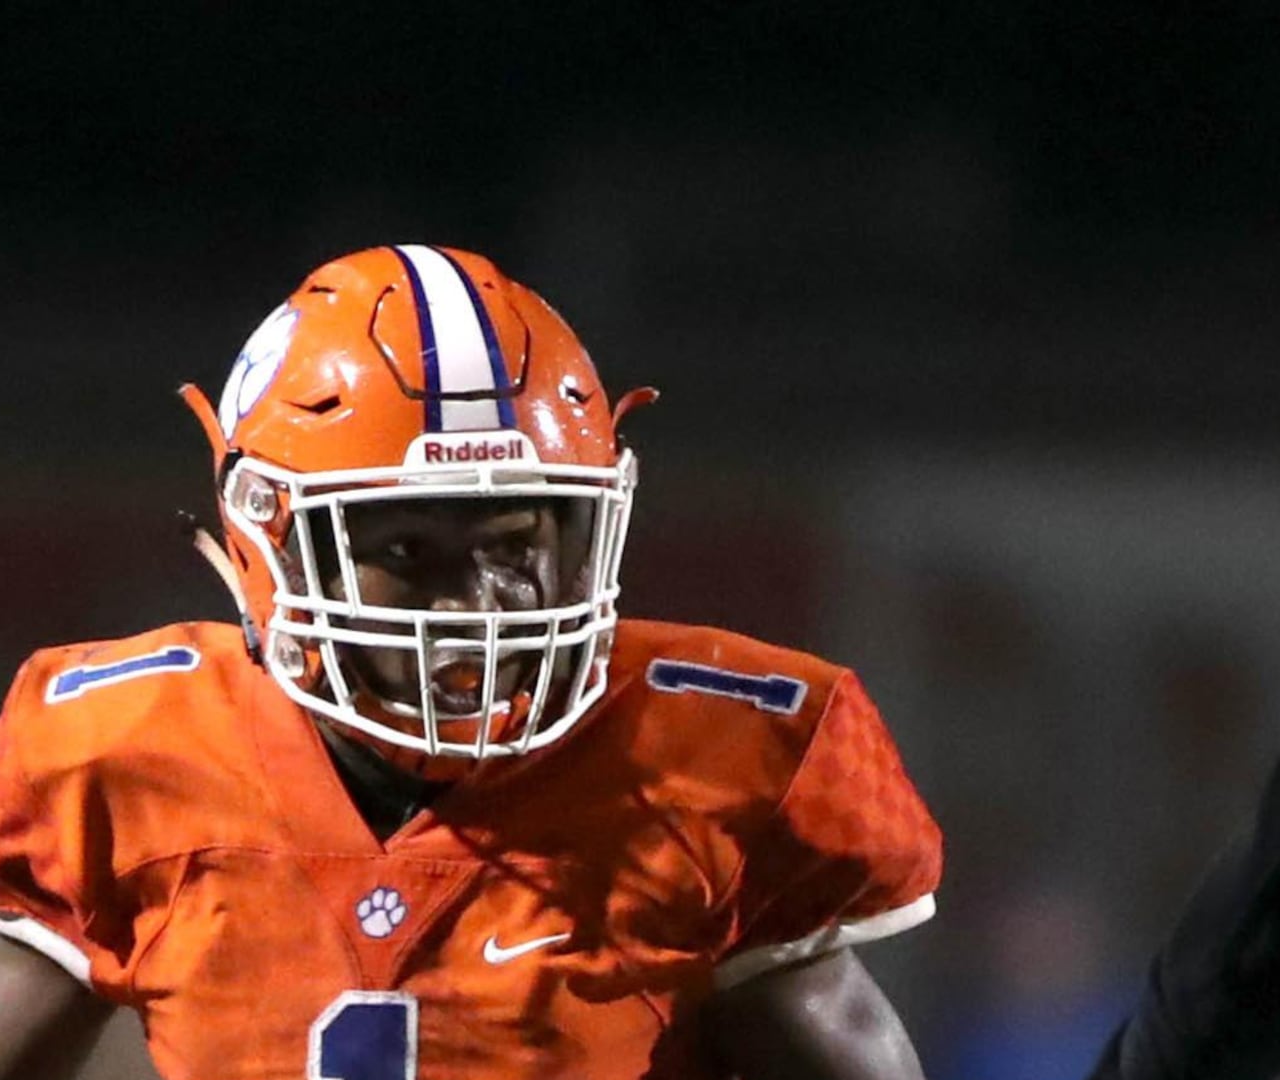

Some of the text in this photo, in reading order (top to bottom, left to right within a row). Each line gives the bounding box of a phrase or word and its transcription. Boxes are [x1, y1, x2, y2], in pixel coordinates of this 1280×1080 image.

[424, 439, 523, 463] Riddell
[46, 646, 200, 701] 1
[647, 658, 807, 715] 1
